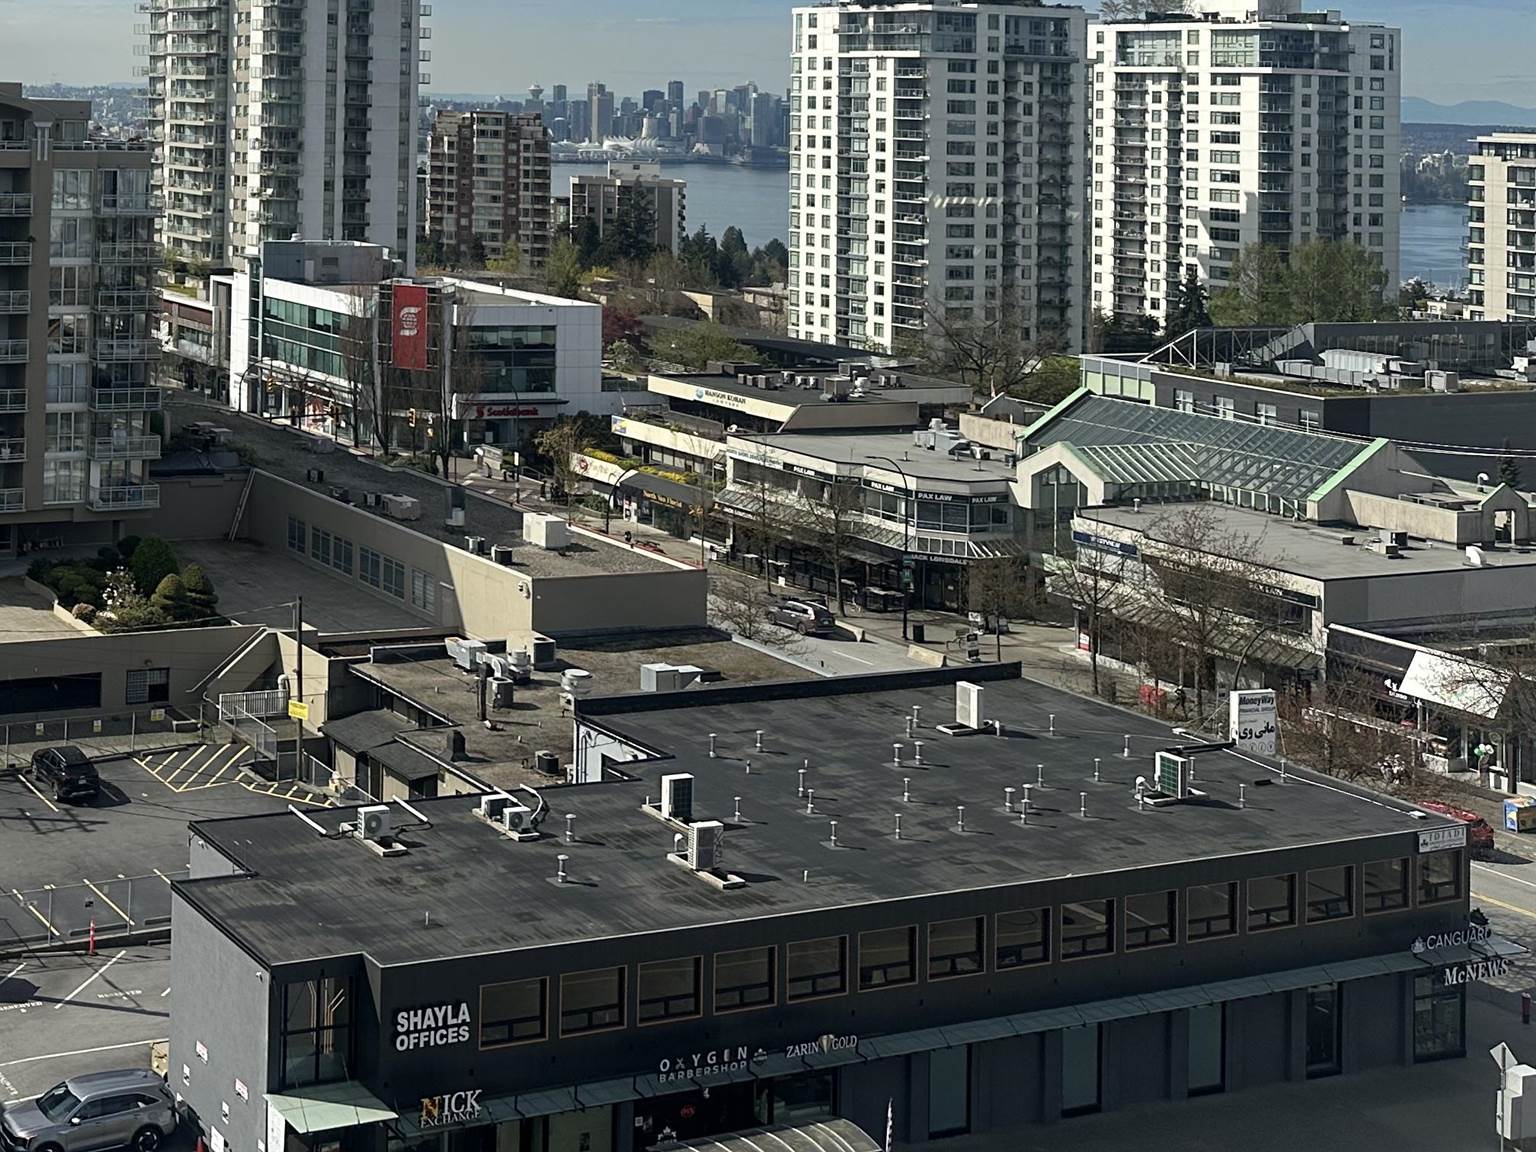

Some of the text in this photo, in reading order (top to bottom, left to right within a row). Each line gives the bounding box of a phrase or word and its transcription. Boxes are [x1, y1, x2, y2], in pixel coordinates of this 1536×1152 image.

[917, 492, 952, 502] PAX LAW
[1444, 959, 1509, 986] McNEWS
[396, 1002, 471, 1032] SHAYLA
[396, 1025, 470, 1051] OFFICES
[786, 1035, 858, 1058] ZARIN GOLD
[659, 1060, 748, 1084] BARBERSHOP
[420, 1089, 483, 1120] NICK
[420, 1108, 482, 1128] EXCHANGE
